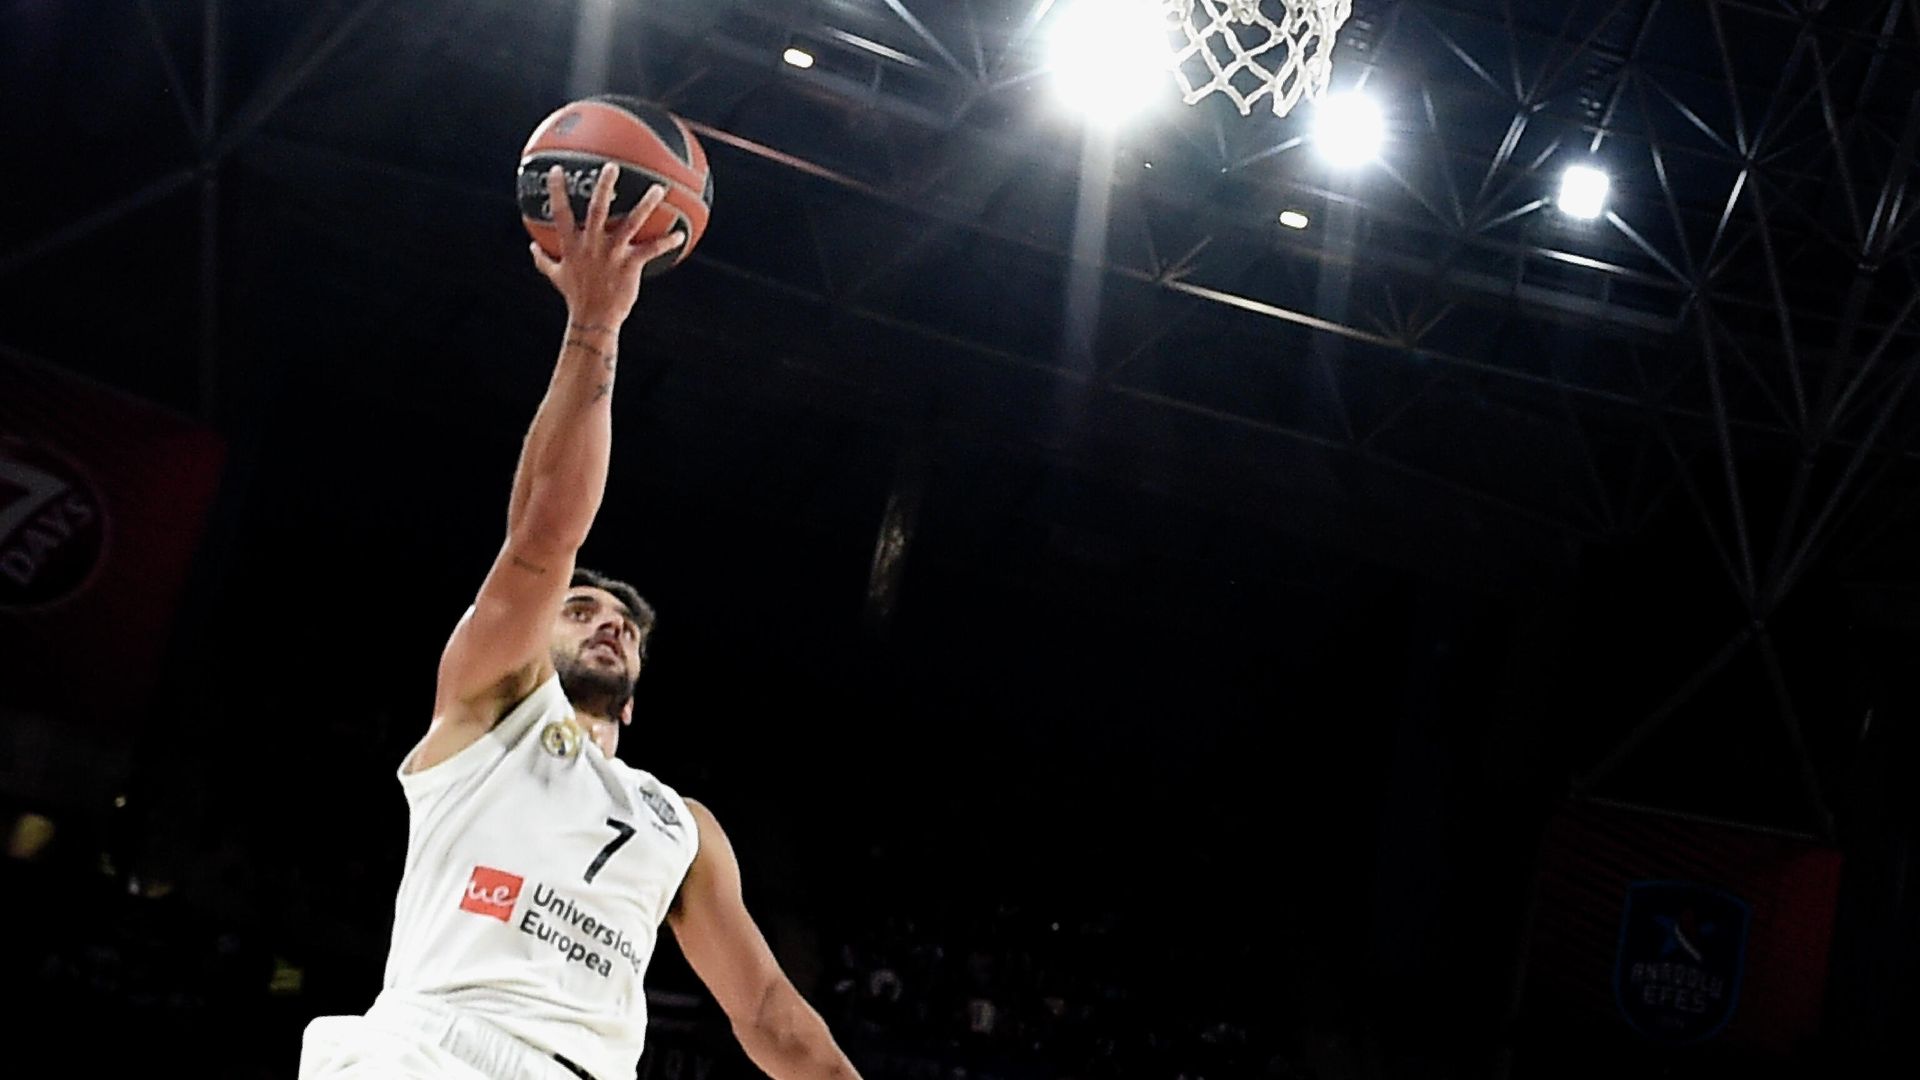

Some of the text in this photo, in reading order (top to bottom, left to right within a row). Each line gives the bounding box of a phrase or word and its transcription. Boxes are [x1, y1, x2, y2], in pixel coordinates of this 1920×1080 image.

[0, 458, 68, 545] 7
[0, 495, 95, 588] DAYS
[583, 816, 637, 884] 7
[519, 909, 612, 977] Europea
[1630, 960, 1725, 1000] ANADOLU
[1641, 984, 1709, 1014] EFES
